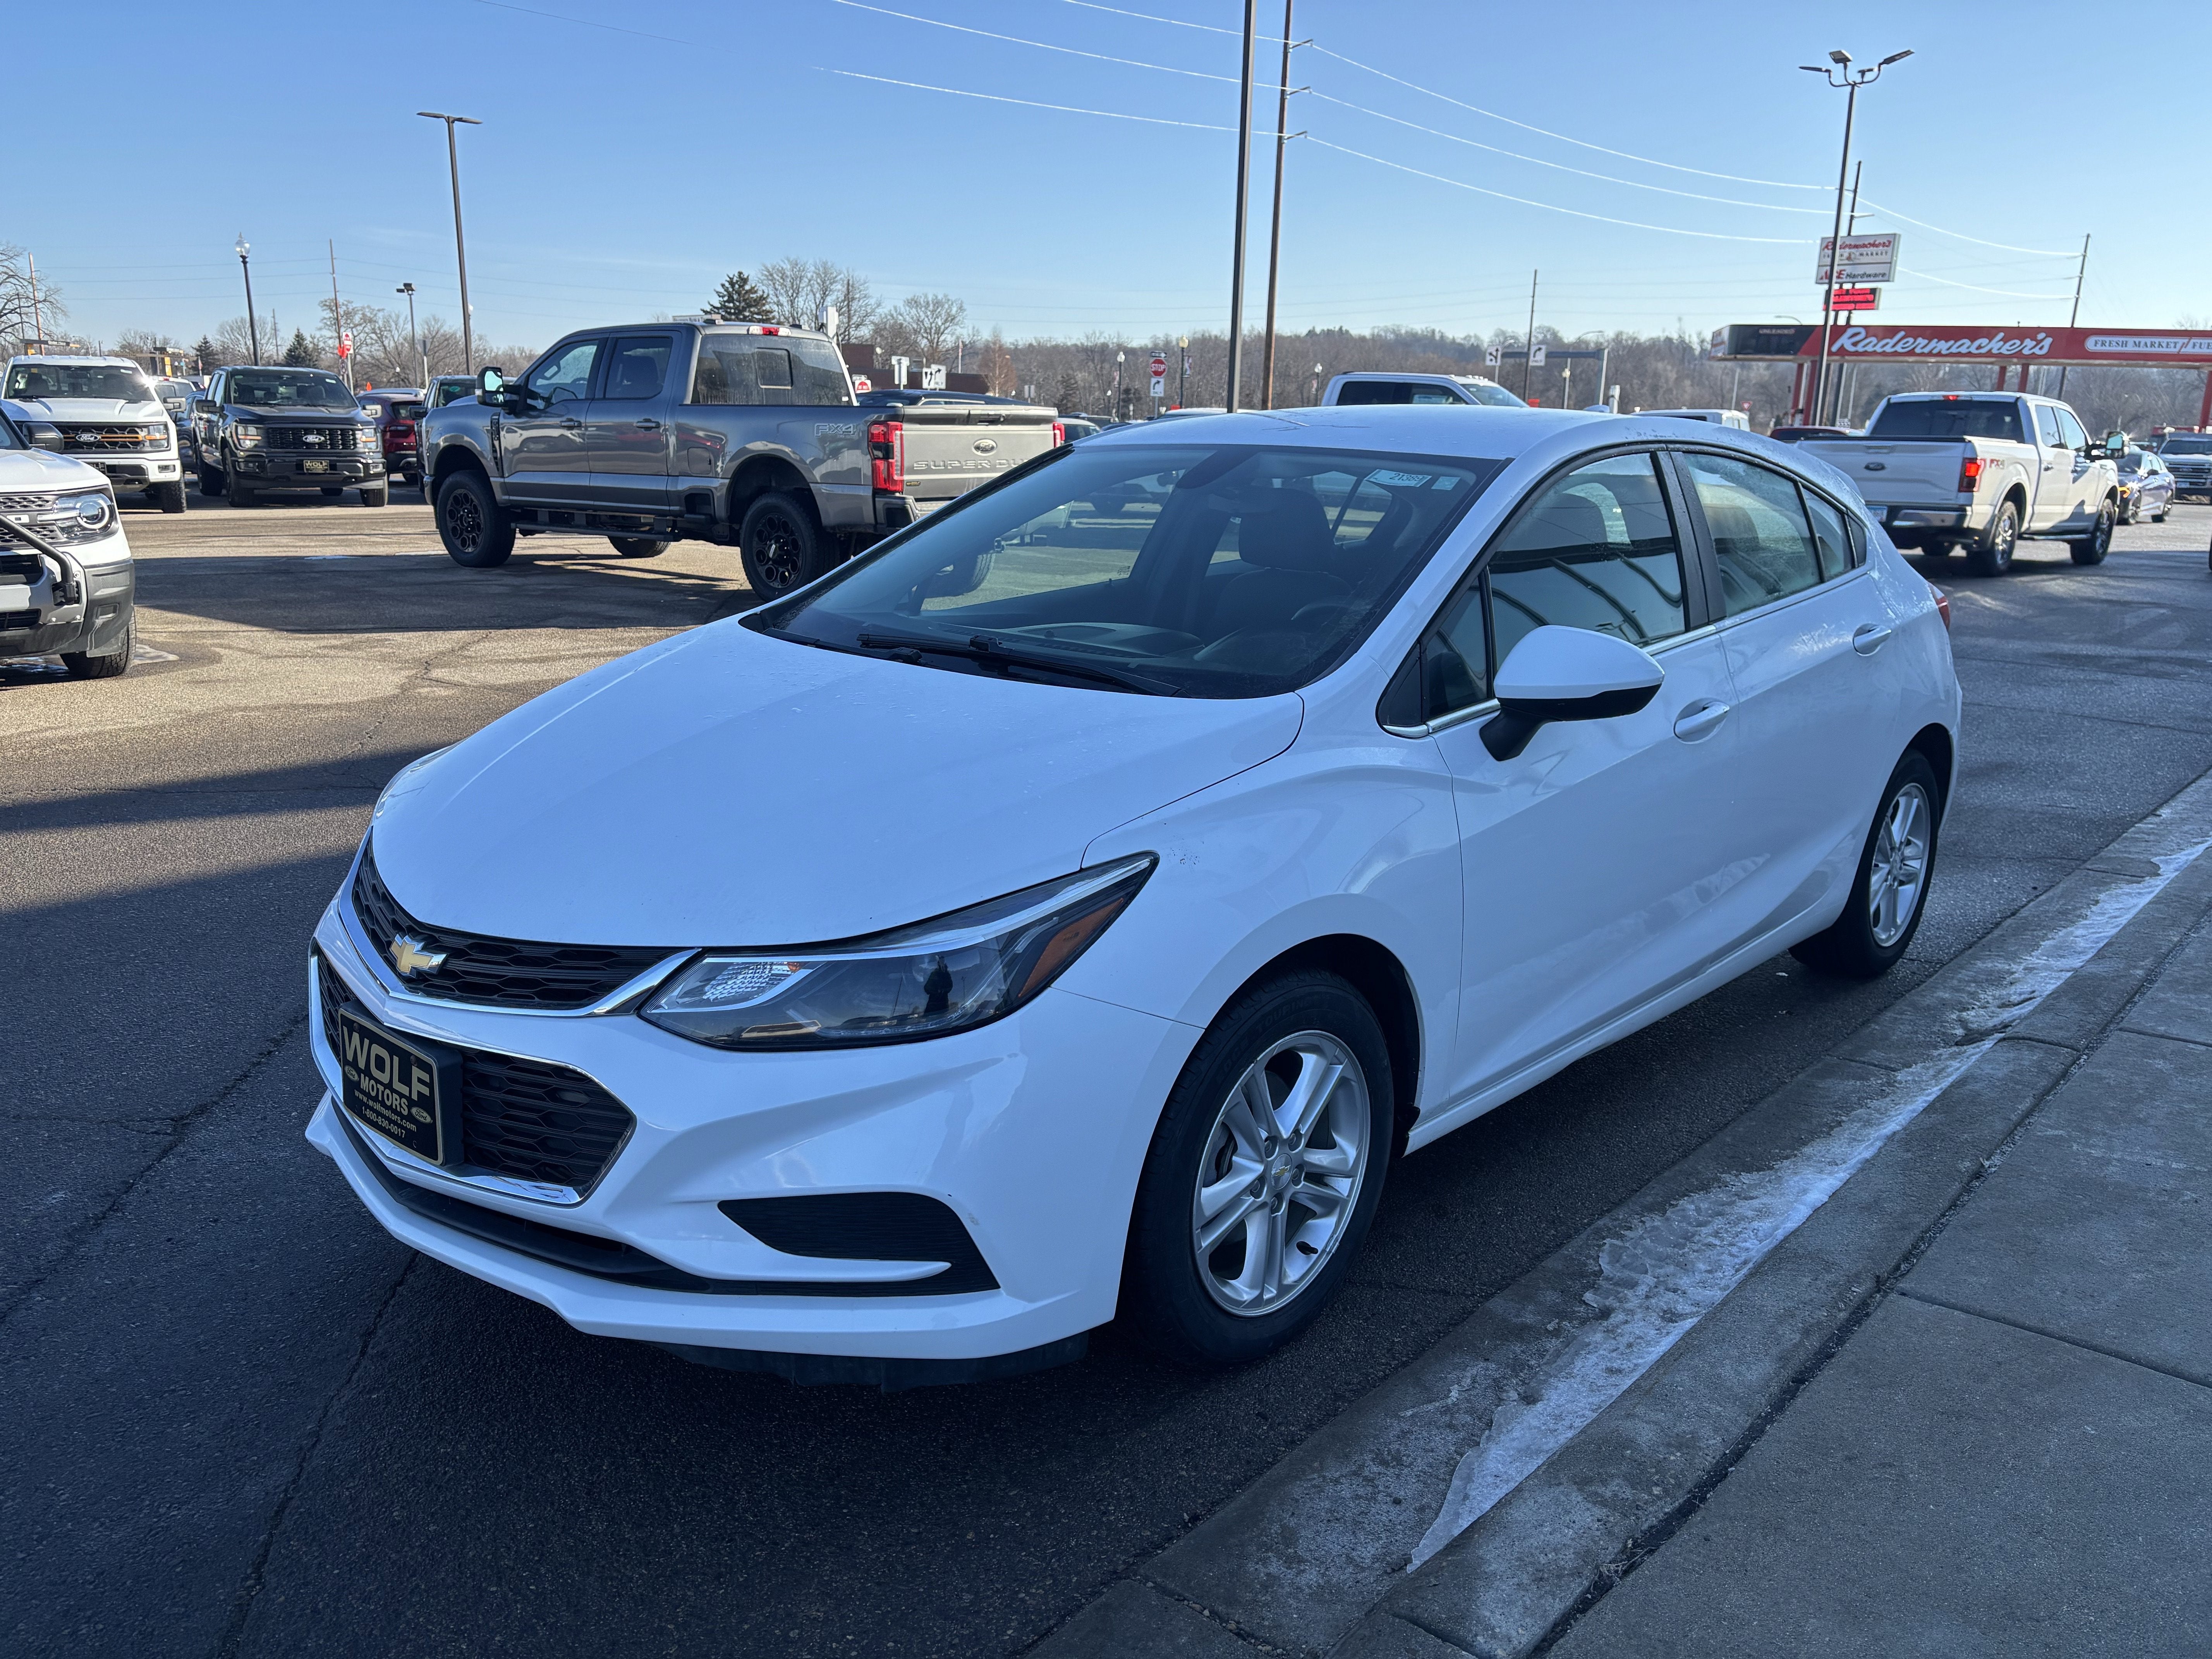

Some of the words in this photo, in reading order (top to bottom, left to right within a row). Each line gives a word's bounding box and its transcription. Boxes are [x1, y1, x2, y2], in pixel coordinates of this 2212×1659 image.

[1822, 239, 1892, 251] Rdermacher's
[1819, 269, 1846, 280] AE
[1831, 327, 2053, 356] Rademacher's
[2094, 339, 2128, 348] FRESH
[2133, 340, 2179, 349] MARKET
[814, 423, 856, 437] FX4
[914, 460, 991, 470] SUPER
[996, 459, 1028, 468] DU
[1389, 473, 1425, 481] 21389
[343, 1025, 429, 1101] WOLF
[360, 1073, 408, 1115] MOTORS
[354, 1089, 417, 1132] www.wolfmotors.com
[362, 1106, 405, 1138] 1-800-830-0017
